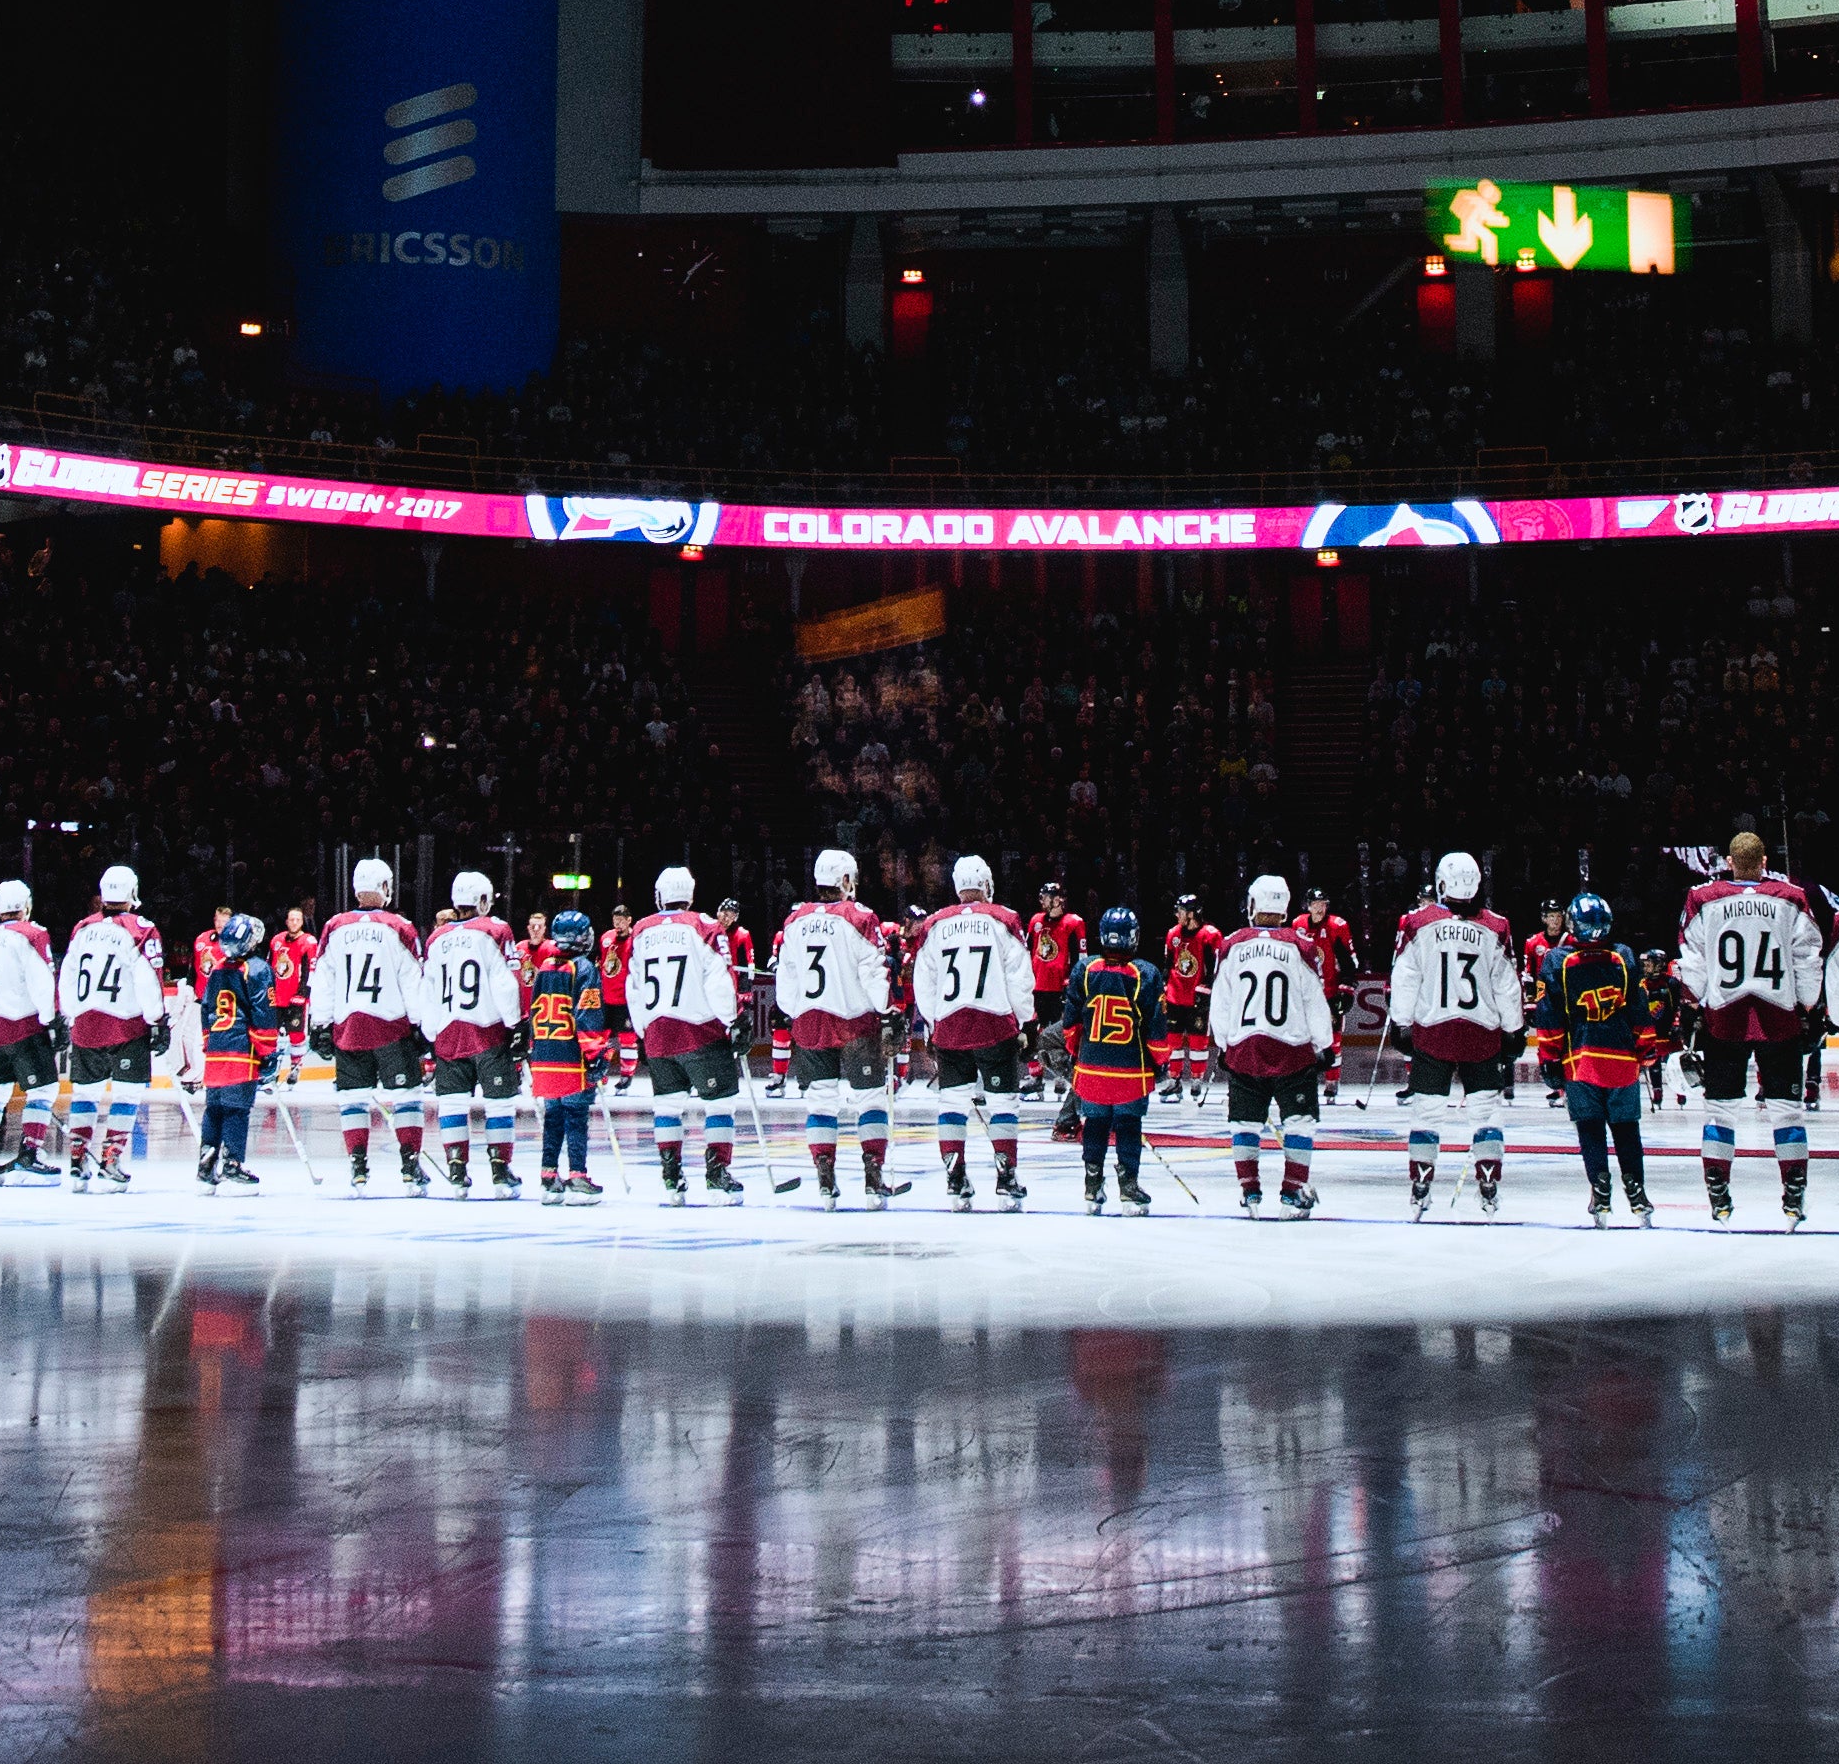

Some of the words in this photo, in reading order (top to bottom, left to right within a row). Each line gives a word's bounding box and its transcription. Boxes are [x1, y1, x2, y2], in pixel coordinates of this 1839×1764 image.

[138, 470, 260, 507] SERIES
[266, 485, 384, 514] SWEDEN
[394, 496, 463, 521] 2017
[763, 512, 995, 545] COLORADO
[1006, 513, 1257, 545] AVALANCHE
[941, 920, 990, 940] COMPHER
[1434, 925, 1484, 947] KERFOOT
[1722, 900, 1778, 921] MIRONOV
[77, 952, 123, 1004] 64
[344, 953, 383, 1004] 14
[804, 945, 828, 1000] 3
[941, 945, 993, 1002] 37
[1238, 944, 1291, 964] GRIMALDI
[1718, 929, 1785, 991] 94
[441, 958, 482, 1013] 49
[643, 954, 689, 1011] 57
[1238, 970, 1289, 1028] 20
[1439, 951, 1480, 1011] 13
[210, 989, 238, 1032] 9
[530, 993, 577, 1041] 25
[1086, 994, 1135, 1045] 15
